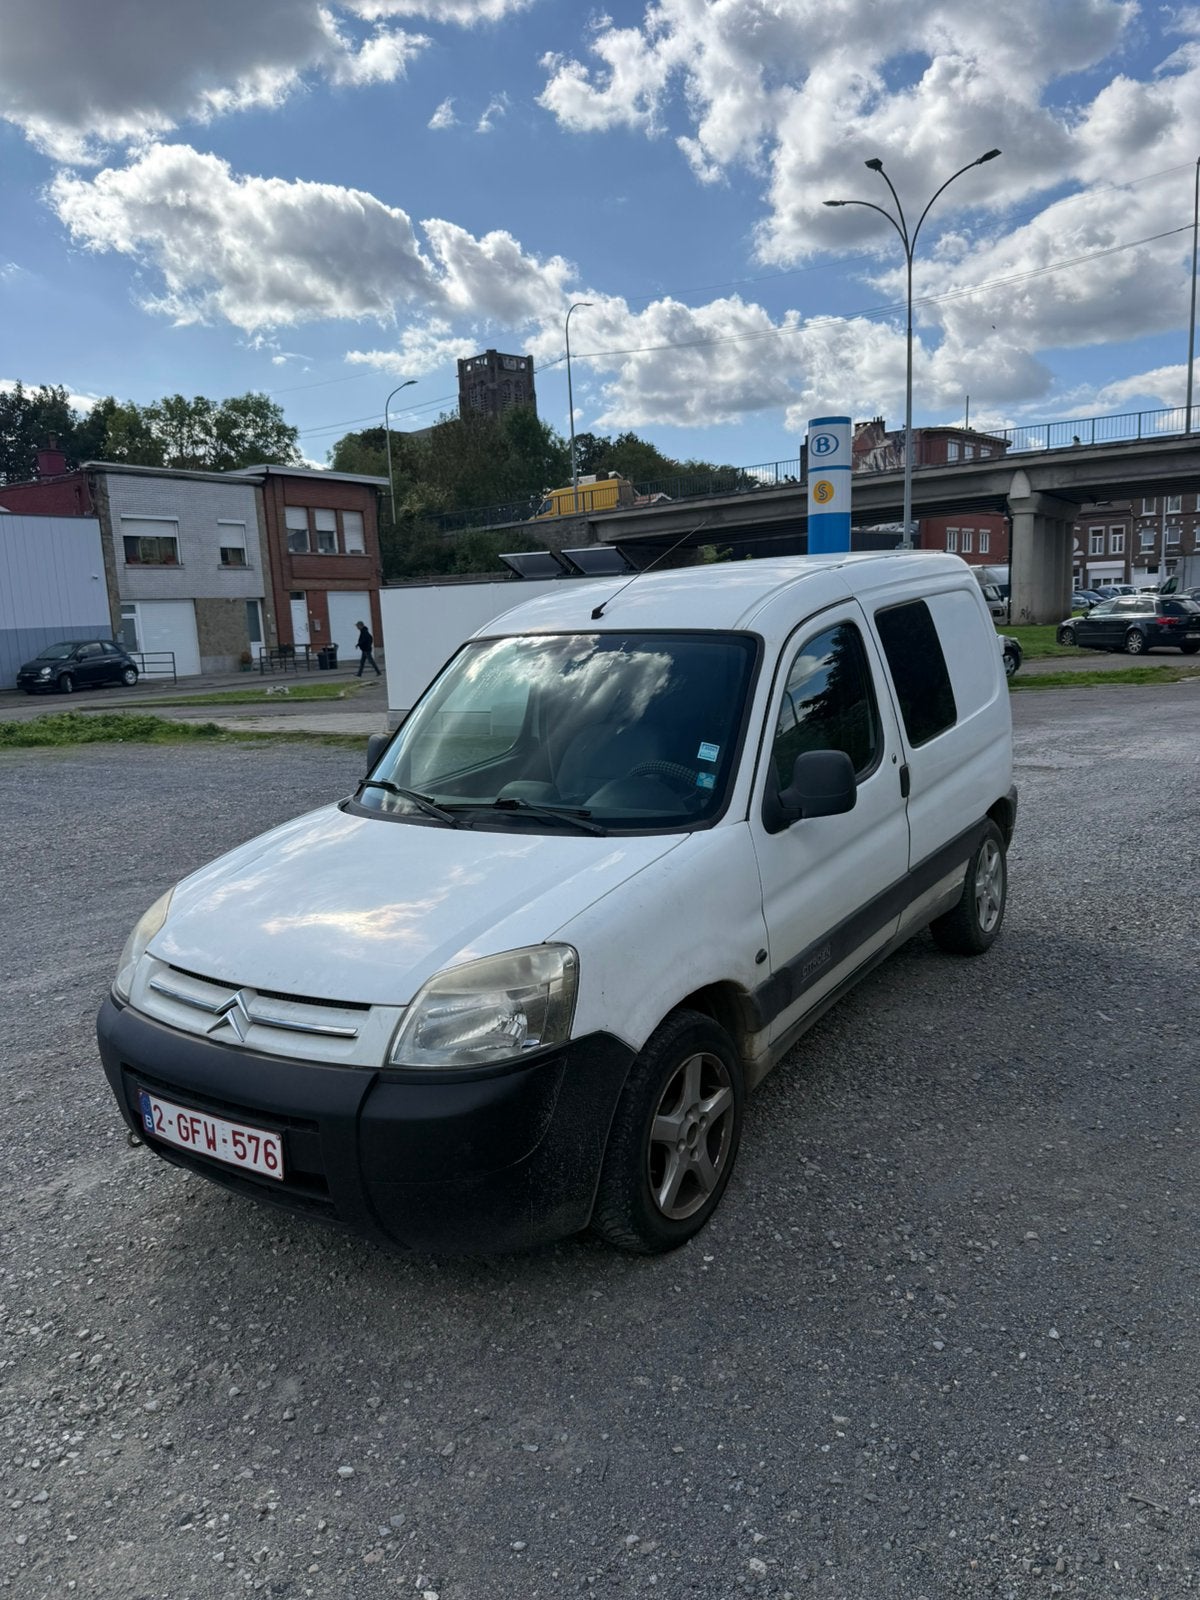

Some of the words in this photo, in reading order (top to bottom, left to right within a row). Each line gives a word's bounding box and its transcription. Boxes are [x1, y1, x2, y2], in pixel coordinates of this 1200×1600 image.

[815, 437, 830, 453] B
[817, 483, 828, 501] S
[145, 1114, 153, 1128] B
